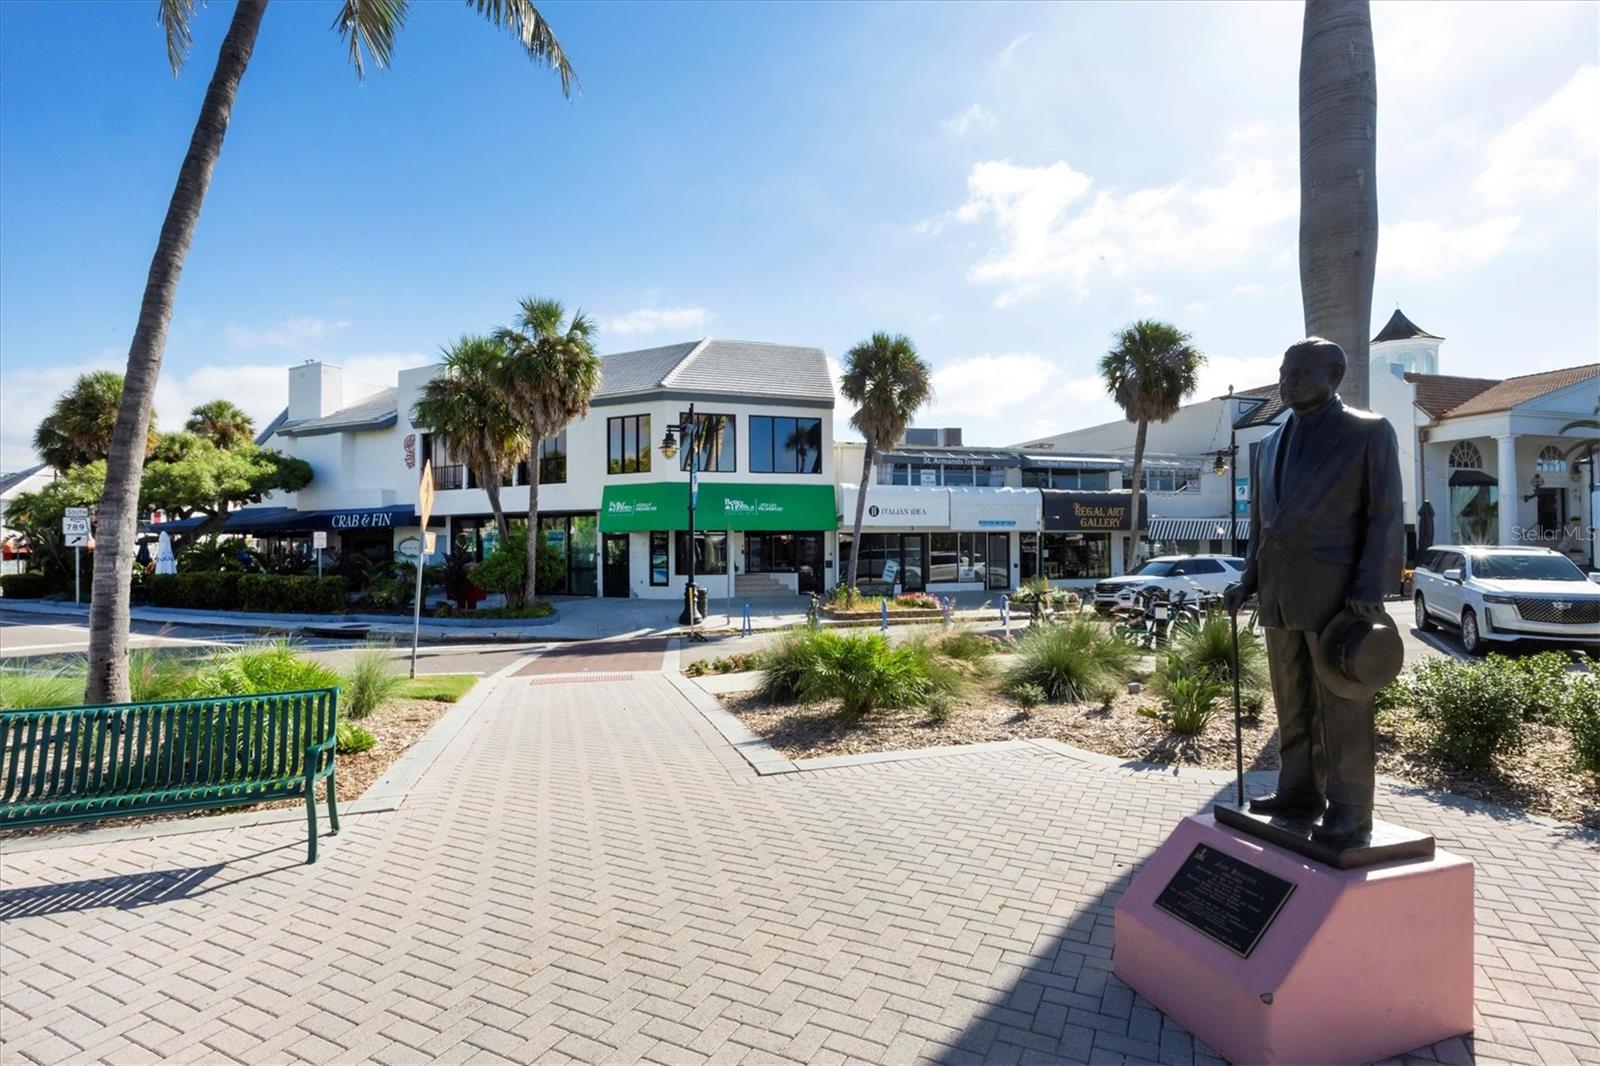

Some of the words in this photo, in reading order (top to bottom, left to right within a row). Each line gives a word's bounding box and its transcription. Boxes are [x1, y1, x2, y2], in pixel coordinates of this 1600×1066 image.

[881, 508, 909, 516] ITALIAN
[910, 508, 927, 516] IDEA
[1075, 506, 1105, 517] REGAL
[1106, 507, 1126, 517] ART
[332, 514, 359, 528] CRAB
[361, 513, 370, 527] &
[371, 512, 392, 526] FIN
[1080, 518, 1122, 528] GALLERY
[66, 523, 84, 531] 789
